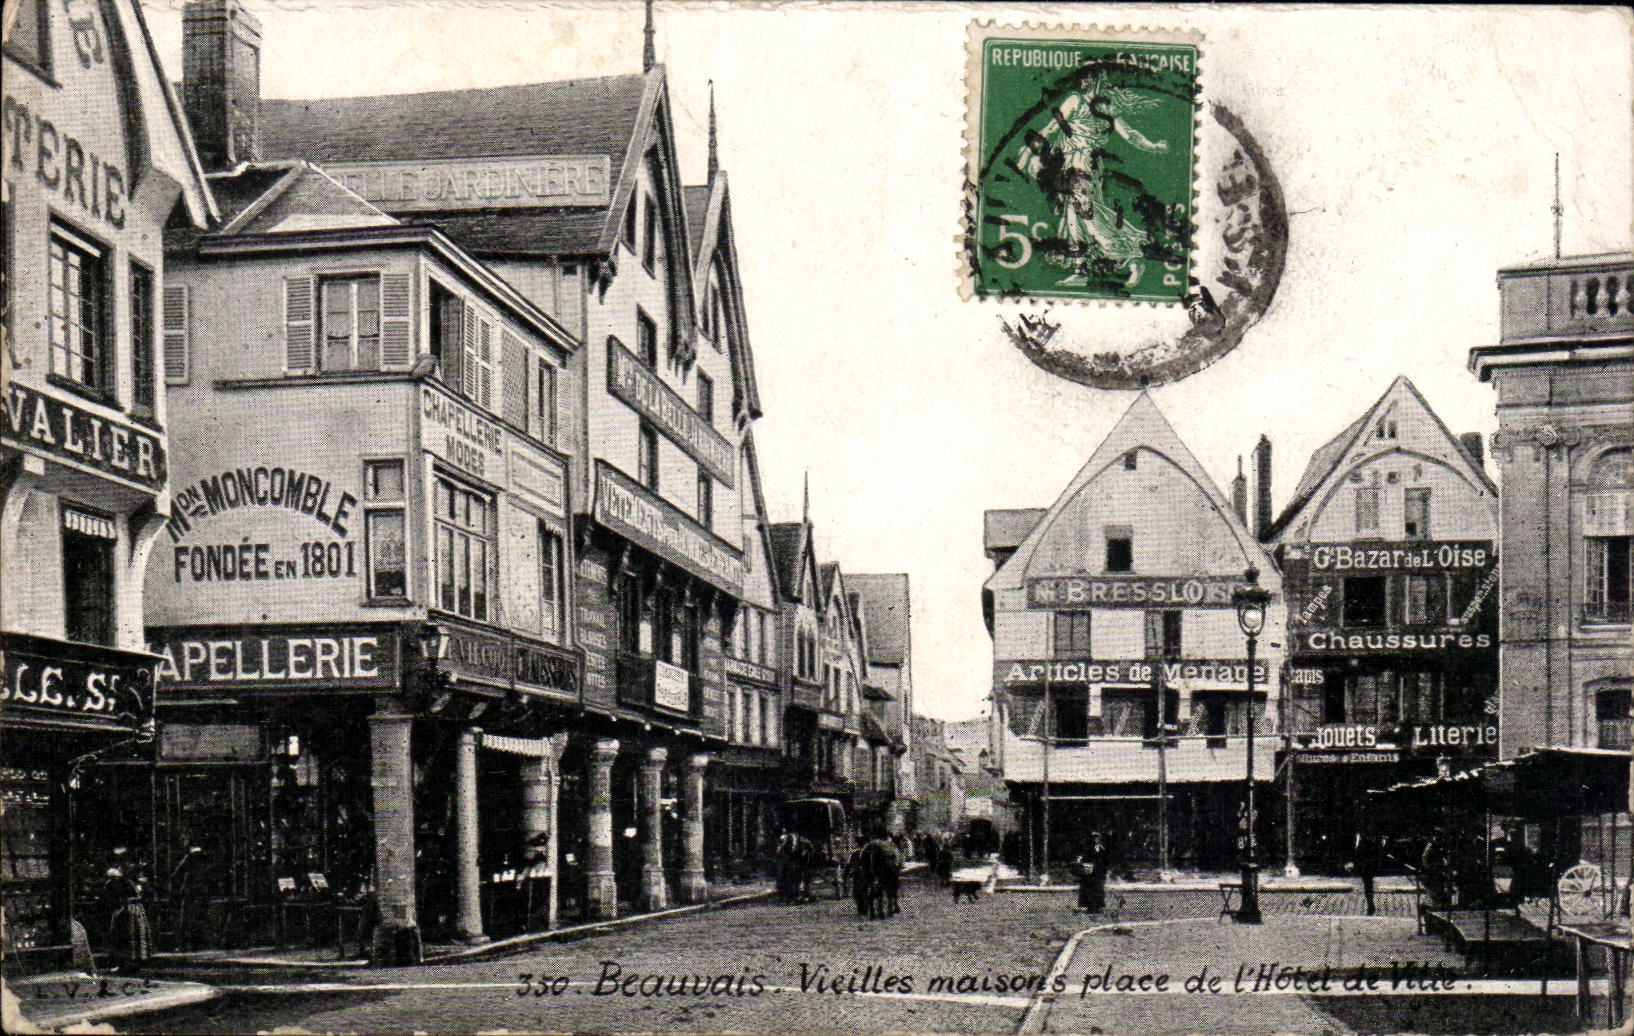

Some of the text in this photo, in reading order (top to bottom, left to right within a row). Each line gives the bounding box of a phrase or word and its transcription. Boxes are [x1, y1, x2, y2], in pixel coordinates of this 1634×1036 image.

[423, 388, 503, 457] CHAPELLERIE
[446, 434, 485, 477] MODES
[200, 466, 358, 539] MONCOMBLE
[174, 536, 357, 584] FONDÉE EN 1801
[1335, 545, 1404, 570] Bazar
[1404, 552, 1422, 568] de
[146, 636, 378, 682] APELLERIE
[1308, 632, 1491, 650] Chaussures
[1006, 662, 1120, 684] Articles
[1129, 662, 1152, 682] de
[1413, 724, 1498, 746] Literie
